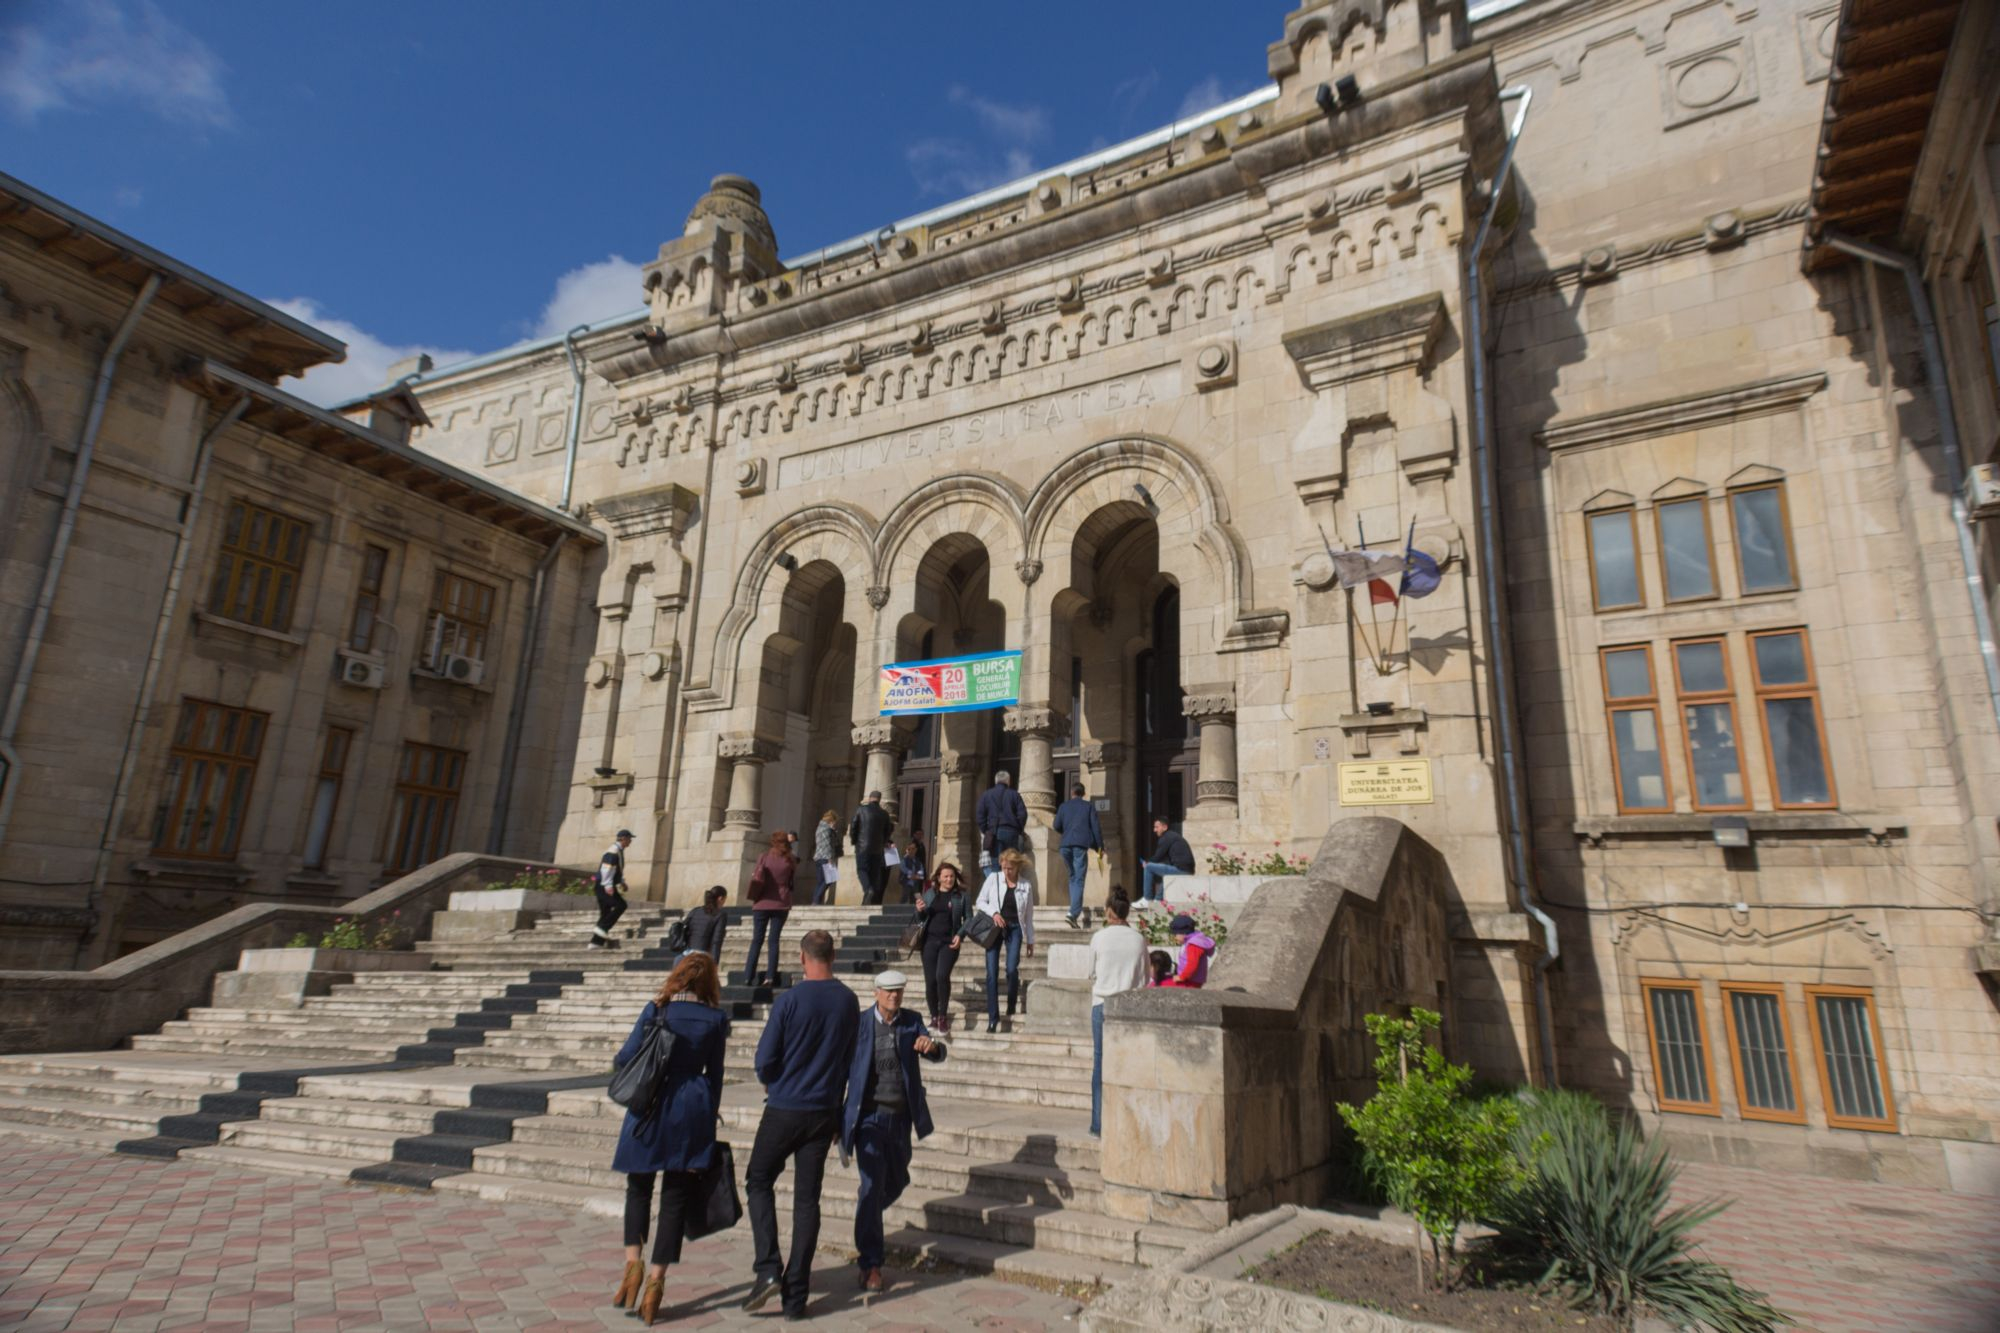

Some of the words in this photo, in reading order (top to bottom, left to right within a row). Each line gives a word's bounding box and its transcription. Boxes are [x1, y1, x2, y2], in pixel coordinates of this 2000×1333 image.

[800, 374, 1156, 481] UNIVERSITATEA
[973, 659, 1015, 676] BURSA
[945, 669, 963, 684] 20
[886, 687, 934, 697] ANOFM
[944, 690, 966, 700] 2018
[976, 693, 987, 701] DE
[884, 698, 911, 706] AJOFM
[1350, 778, 1418, 786] UNIVERSITATEA
